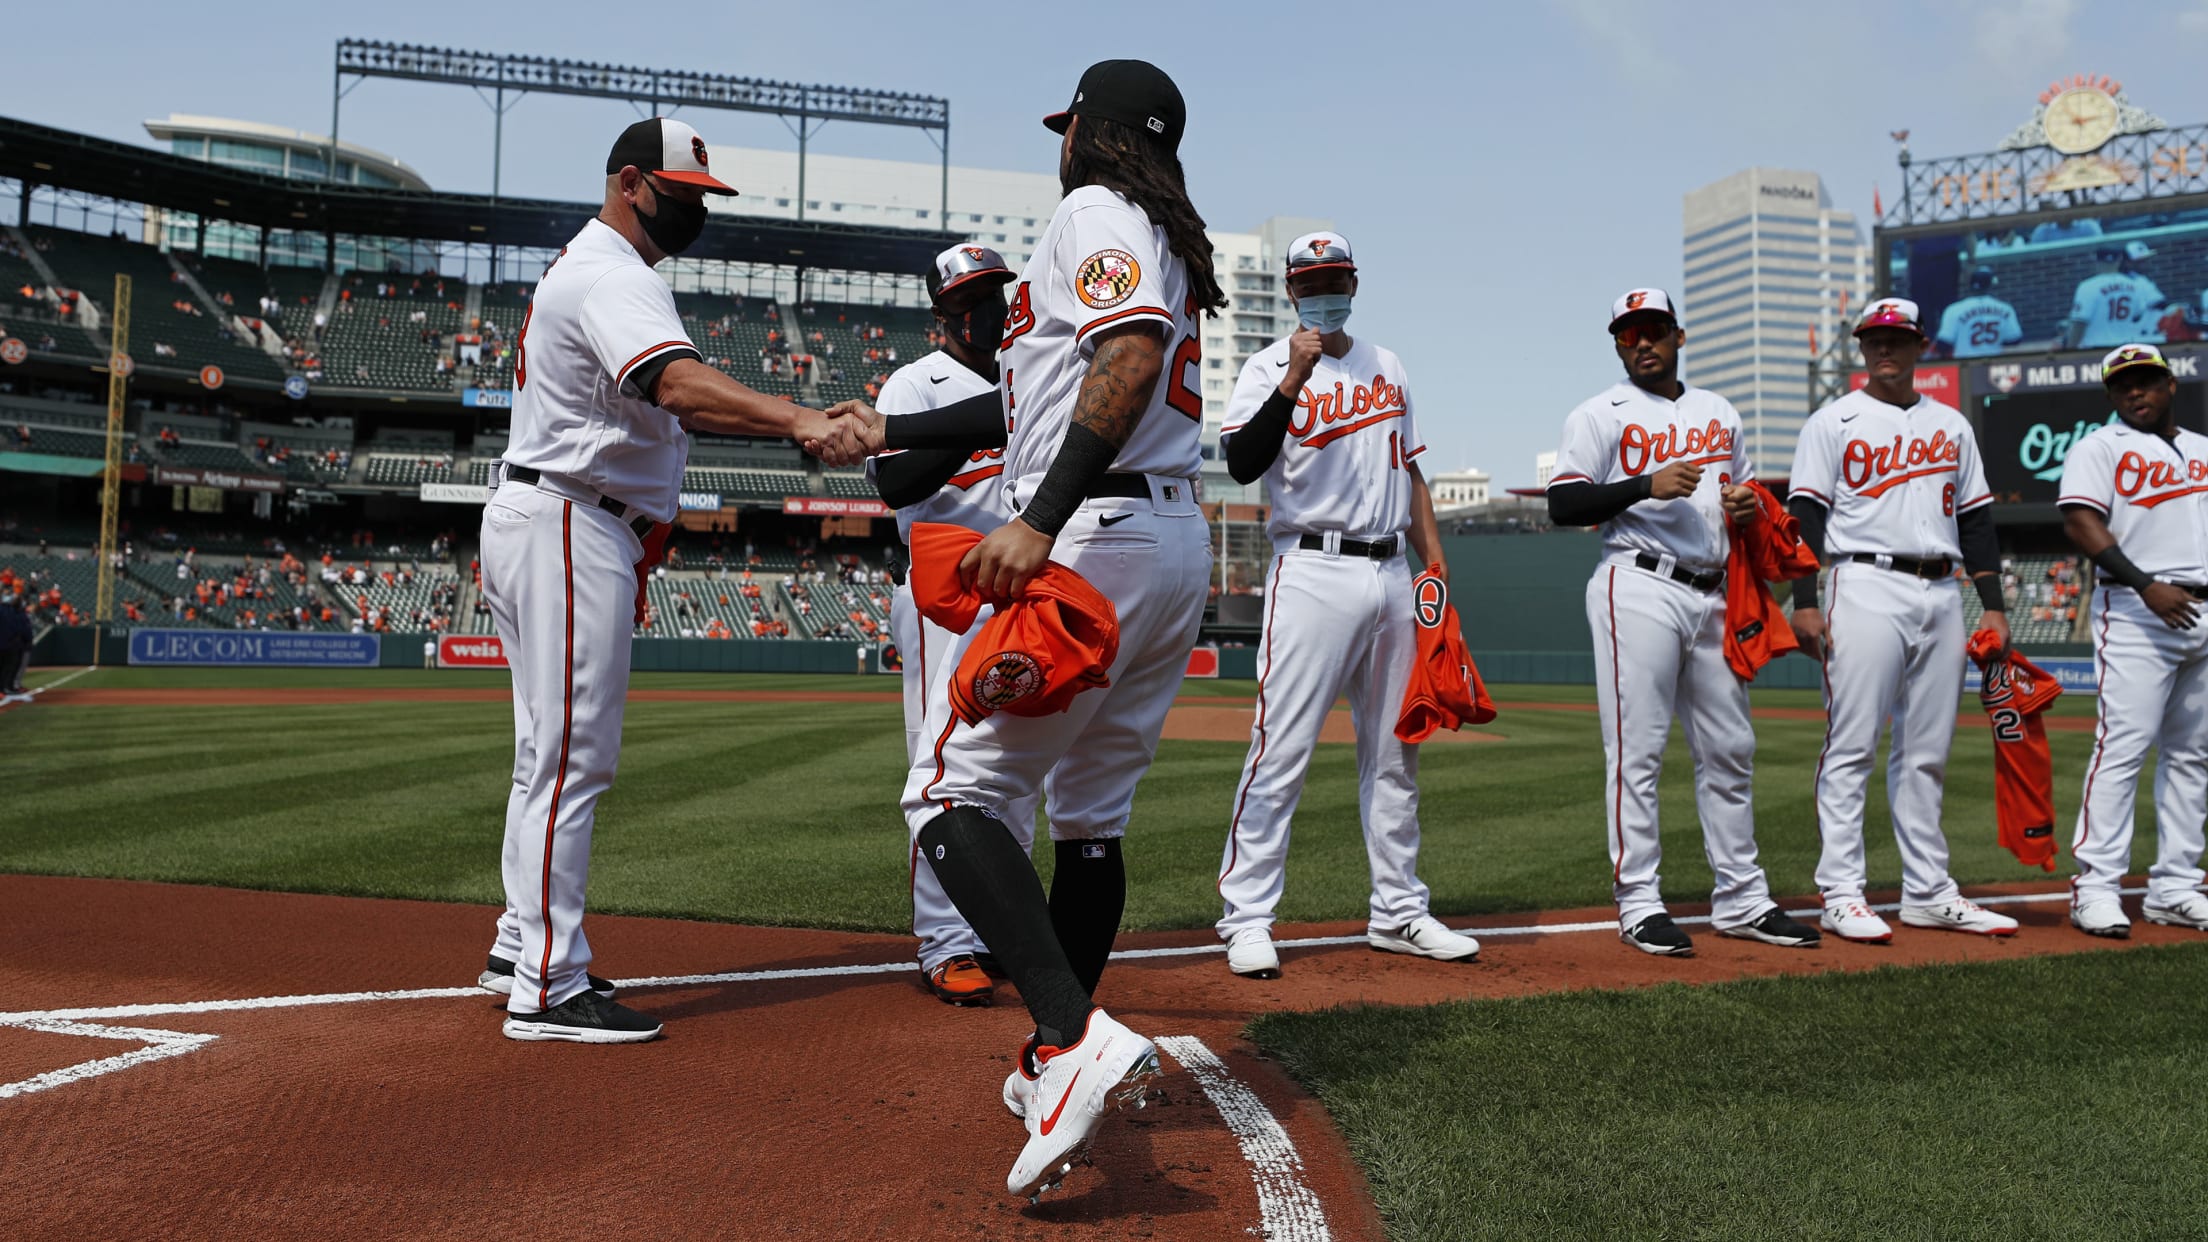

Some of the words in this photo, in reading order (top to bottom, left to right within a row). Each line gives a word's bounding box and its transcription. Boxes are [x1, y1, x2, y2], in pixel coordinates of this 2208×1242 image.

[1078, 250, 1133, 279] BALTIMORE
[1090, 286, 1135, 308] ORIOLES
[2108, 297, 2131, 321] 16
[1970, 321, 2000, 346] 25
[2027, 365, 2076, 387] MLB
[423, 485, 484, 498] GUINNESS
[1942, 482, 1957, 517] 6
[807, 501, 847, 512] JOHNSON
[849, 502, 882, 513] LUMBER
[145, 635, 265, 659] LECOM
[313, 641, 347, 649] COLLEGE
[450, 641, 499, 658] weis
[1992, 708, 2023, 742] 2
